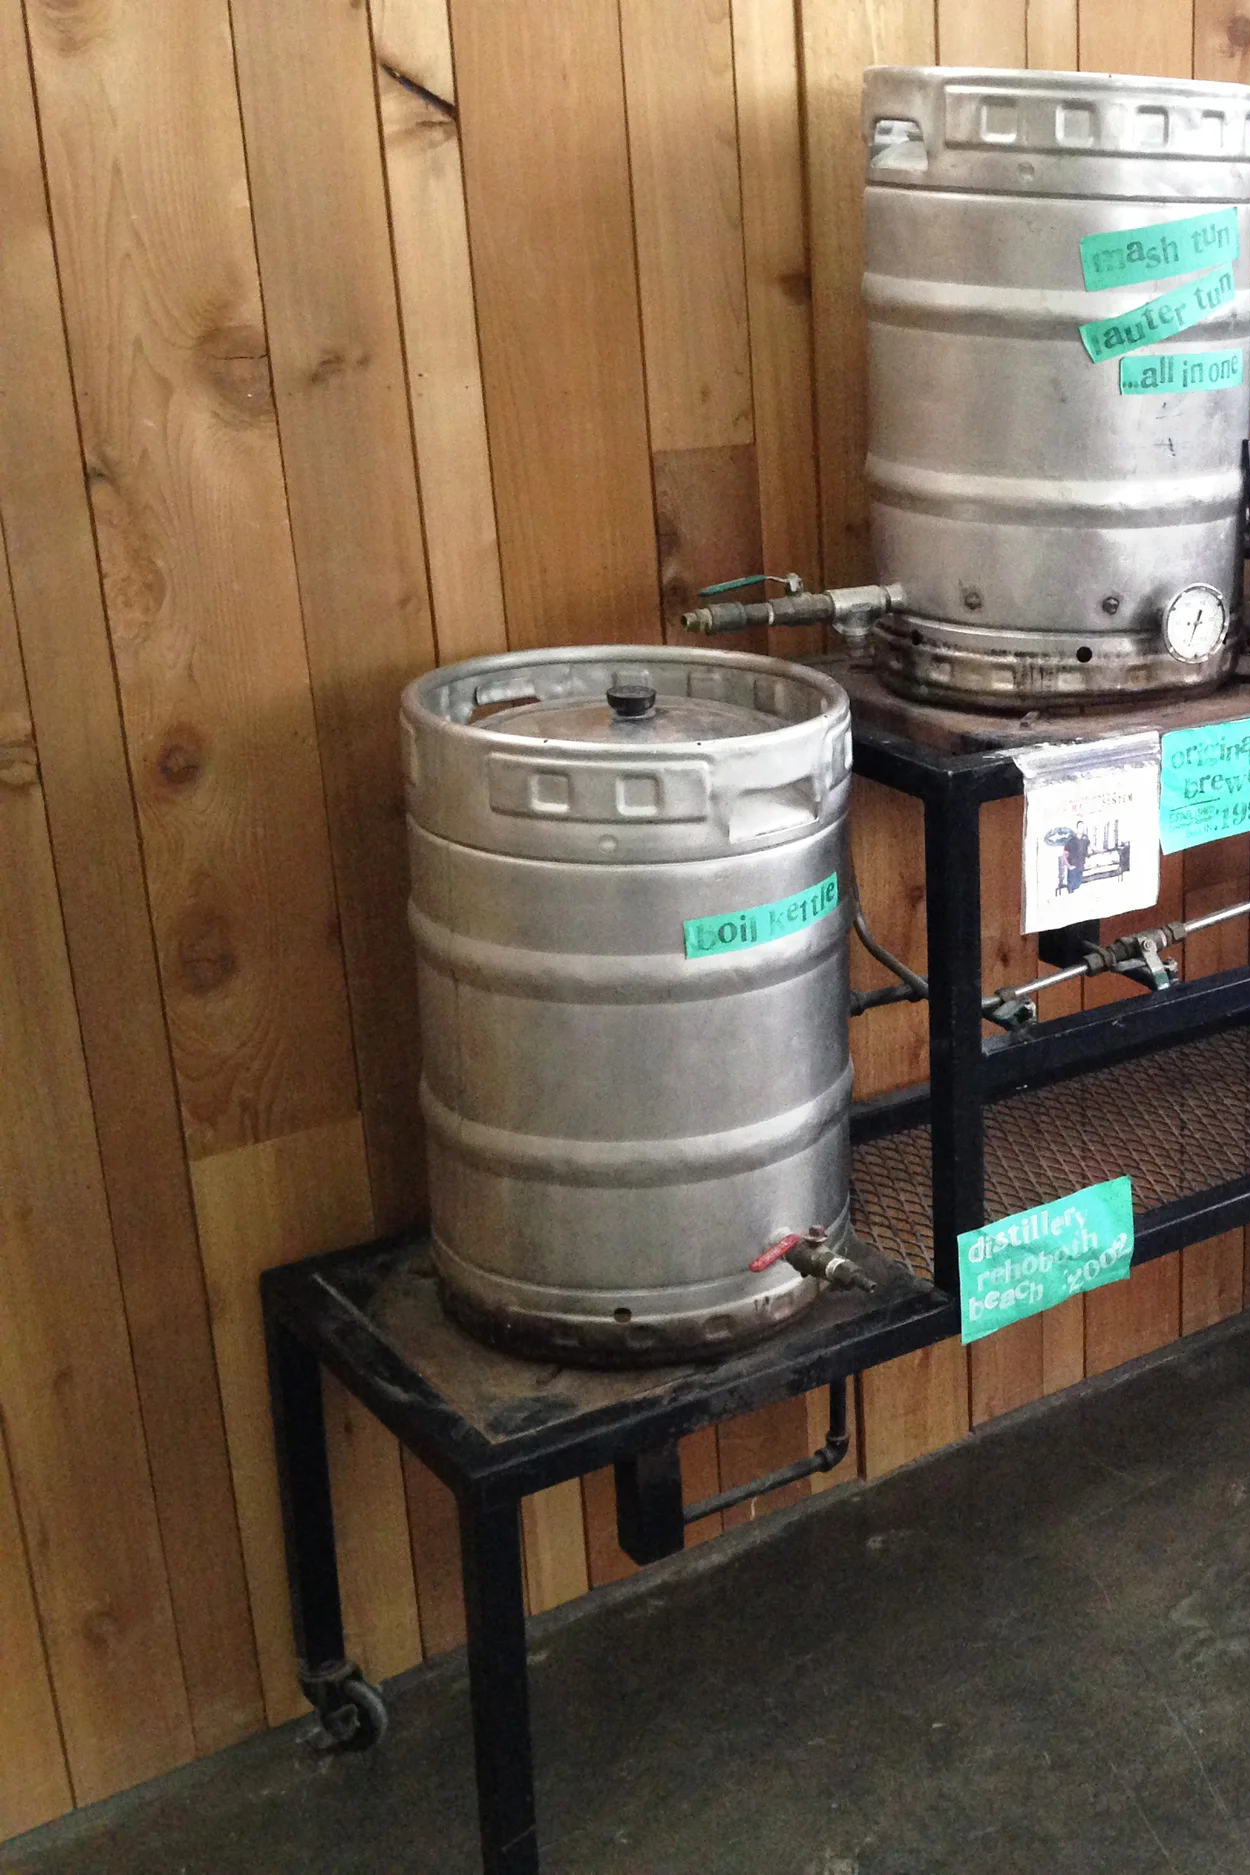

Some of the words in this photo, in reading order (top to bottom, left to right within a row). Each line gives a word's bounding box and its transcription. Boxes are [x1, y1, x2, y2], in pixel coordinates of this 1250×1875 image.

[1092, 236, 1180, 273] mash
[1190, 223, 1231, 254] tun
[1090, 301, 1187, 356] lauter
[1193, 271, 1232, 311] tun
[1182, 360, 1204, 388] in
[1208, 355, 1239, 380] one
[695, 914, 758, 951] boil
[768, 881, 835, 936] kettle
[968, 1206, 1088, 1263] distillery
[977, 1227, 1099, 1292] rehoboth
[968, 1280, 1044, 1321] beach
